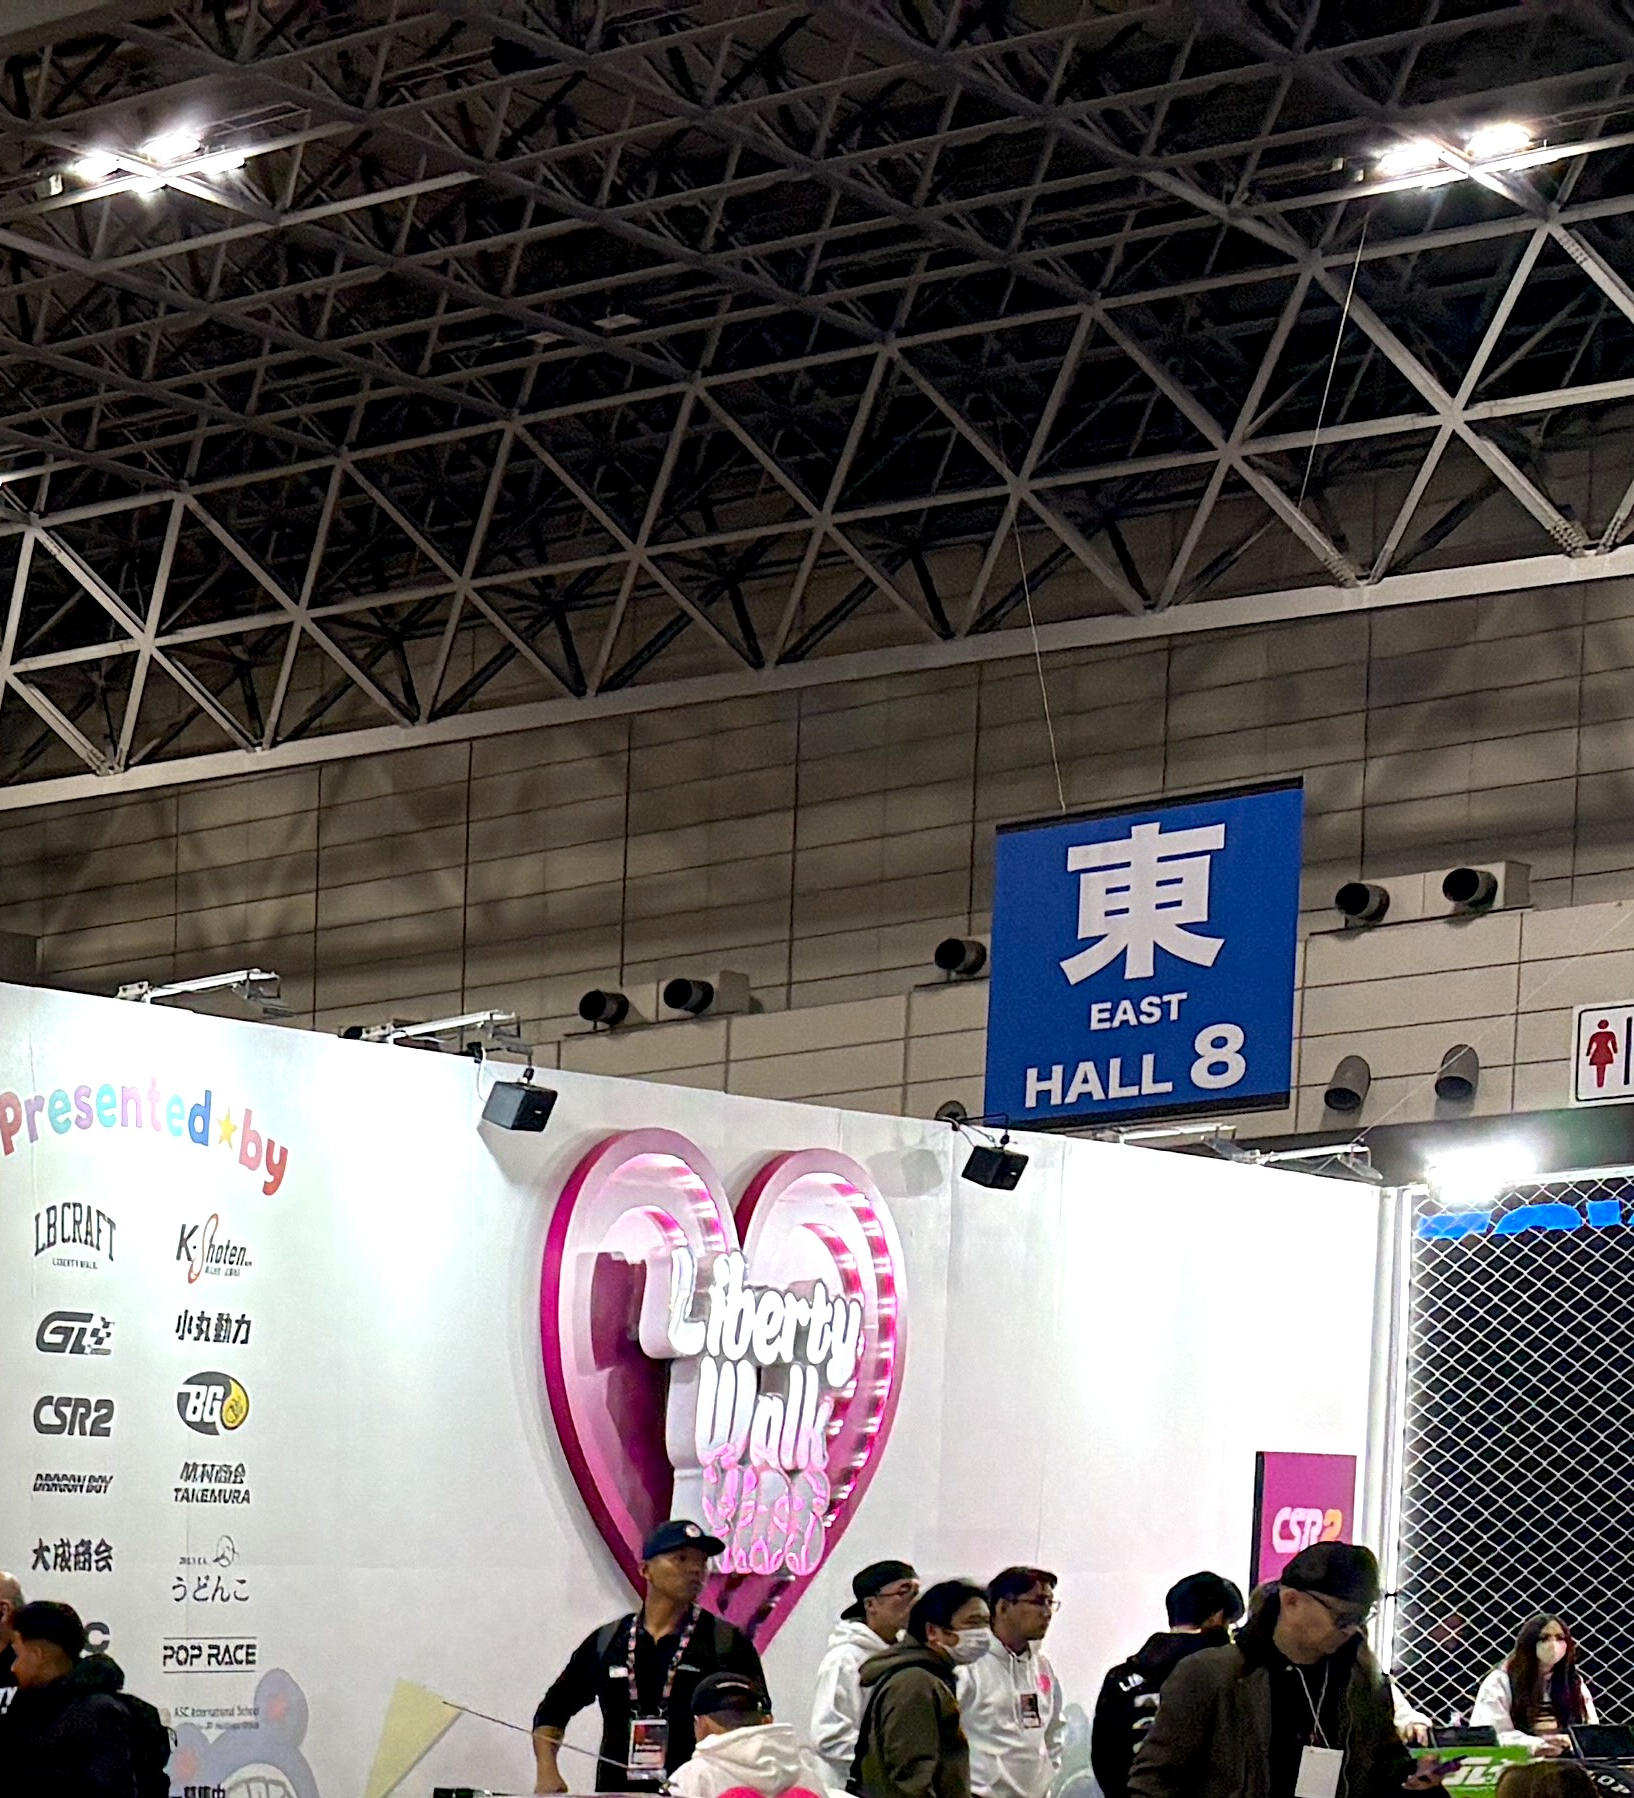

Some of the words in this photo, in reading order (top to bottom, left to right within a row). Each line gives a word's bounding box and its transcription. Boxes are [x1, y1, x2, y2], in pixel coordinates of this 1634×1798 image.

[1060, 822, 1225, 985] 東
[1090, 992, 1188, 1030] EAST
[1025, 1053, 1173, 1108] HALL
[1190, 1022, 1247, 1089] 8
[239, 1108, 288, 1196] by
[60, 1202, 116, 1262] CRAFT
[669, 1247, 864, 1387] Liberty
[33, 1395, 115, 1437] CSR2
[695, 1356, 833, 1470] Walk
[173, 1487, 251, 1504] TAKEMURA
[1272, 1507, 1343, 1554] CSR2
[32, 1537, 113, 1572] 大成商会
[172, 1575, 250, 1602] うどんこ
[163, 1645, 202, 1667] POP
[207, 1644, 257, 1666] RACE
